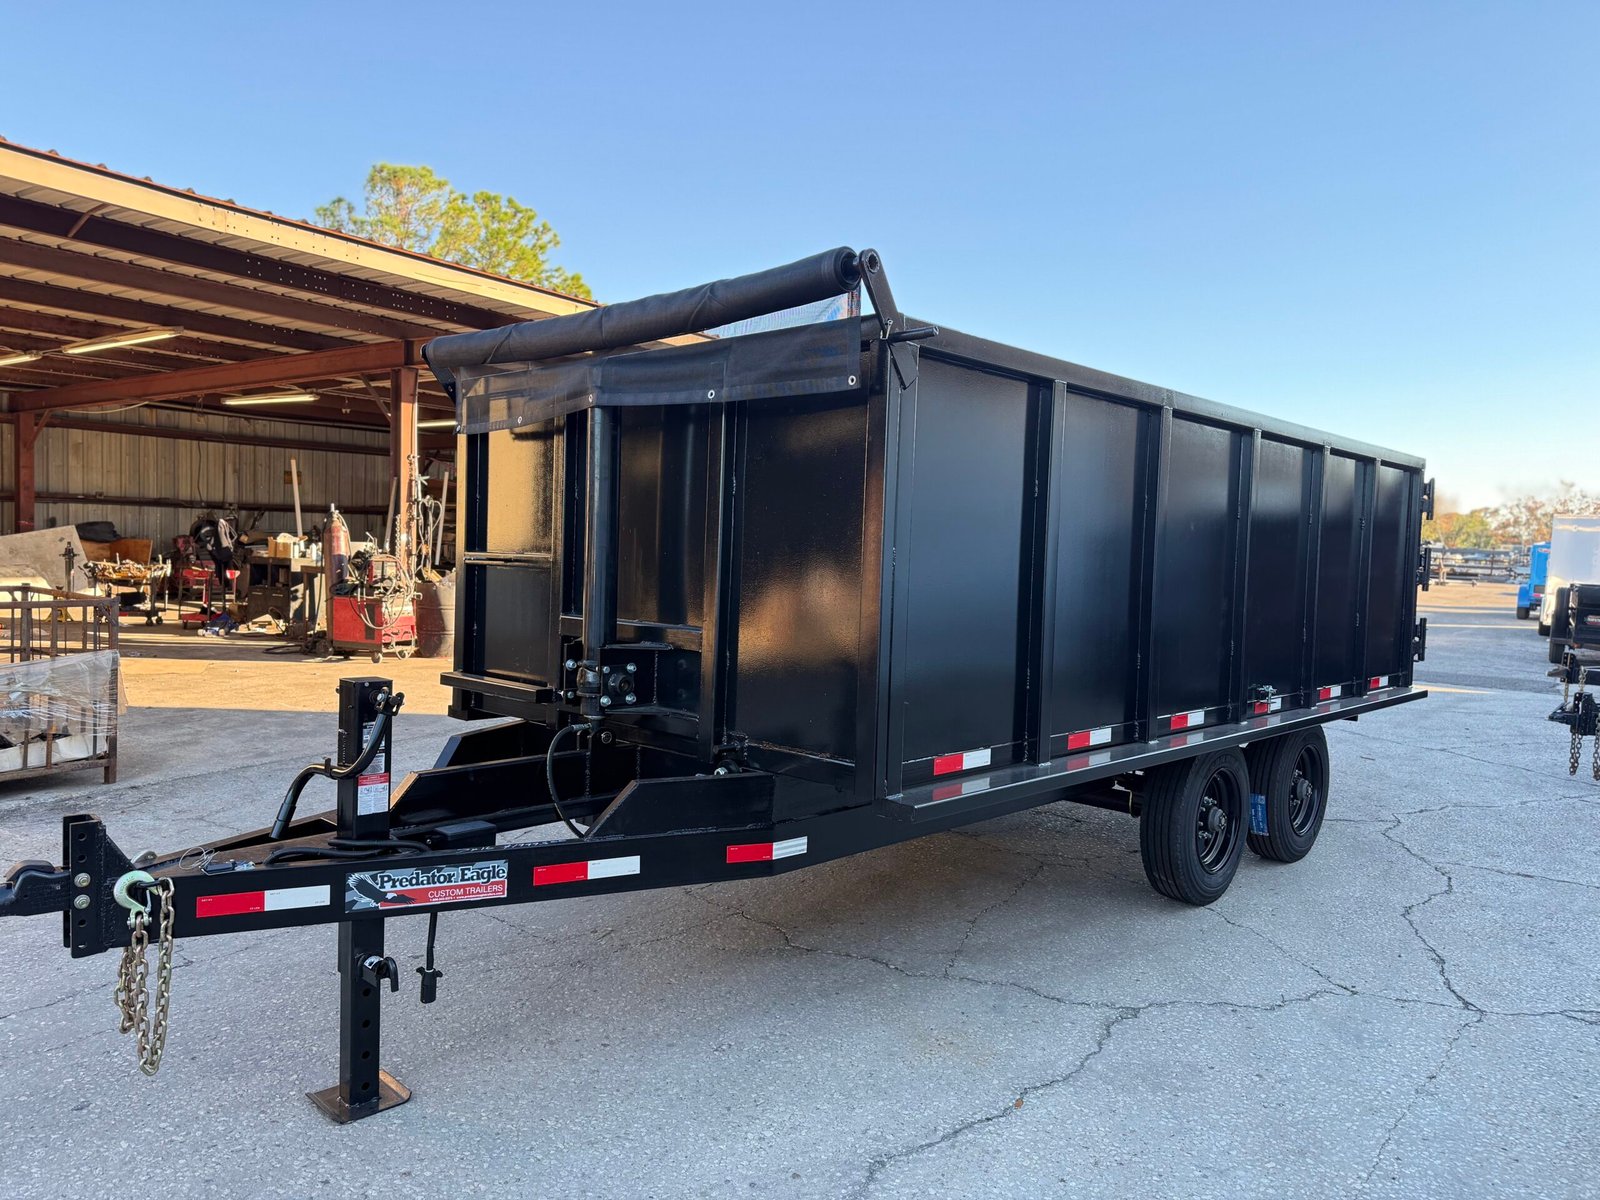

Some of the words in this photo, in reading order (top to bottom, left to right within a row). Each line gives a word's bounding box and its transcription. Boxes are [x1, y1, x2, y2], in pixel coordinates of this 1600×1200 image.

[379, 869, 456, 889] Predator
[459, 864, 506, 884] Eagle
[428, 888, 463, 898] CUSTOM
[465, 884, 503, 894] TRAILERS
